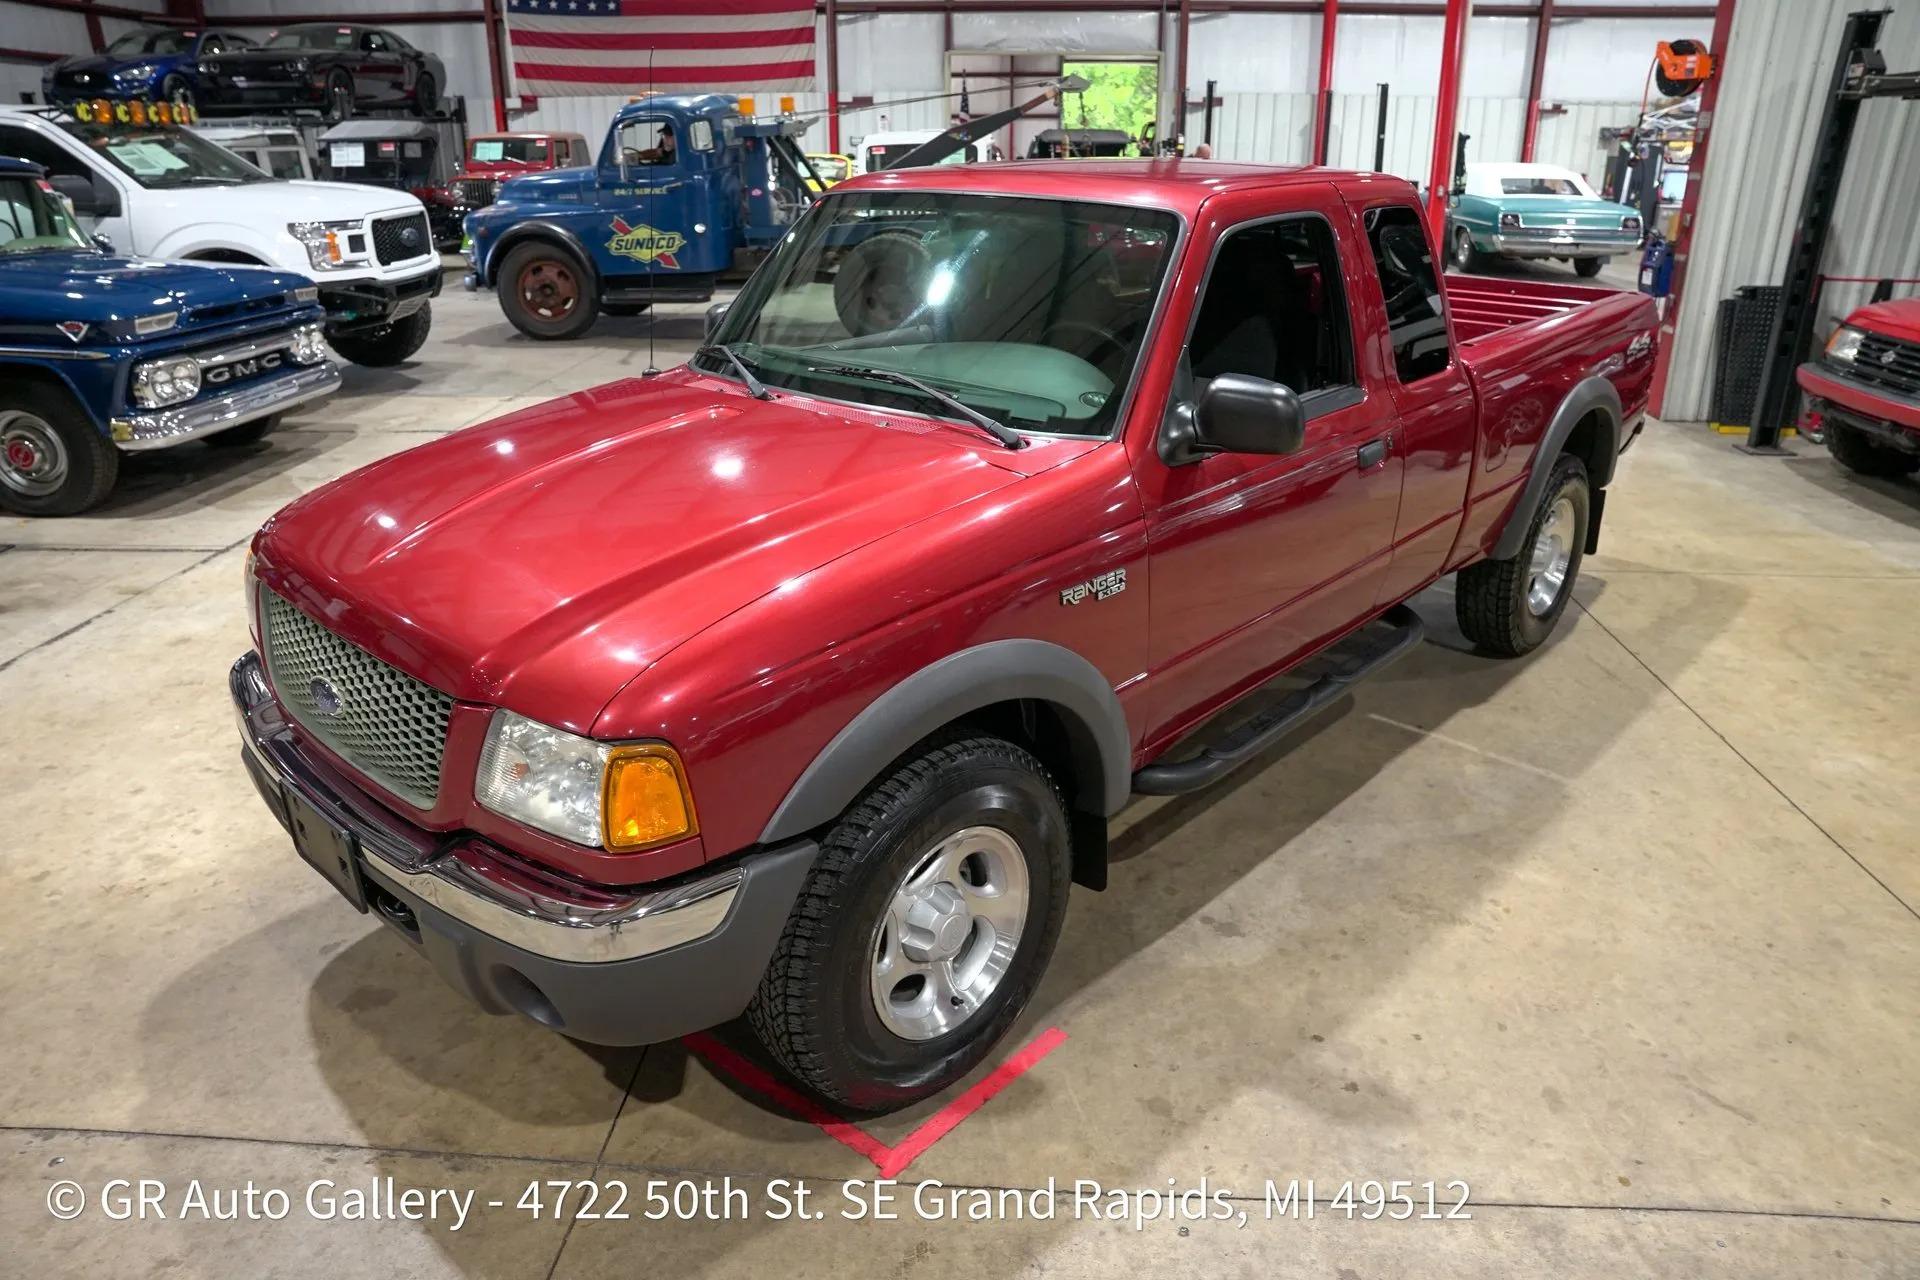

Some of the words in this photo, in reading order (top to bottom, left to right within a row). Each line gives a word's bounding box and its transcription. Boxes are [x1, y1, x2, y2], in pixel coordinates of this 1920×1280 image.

[614, 236, 676, 251] SUNOCO
[206, 353, 282, 383] GMC
[1060, 567, 1127, 605] RANGER
[1100, 583, 1125, 599] XLT
